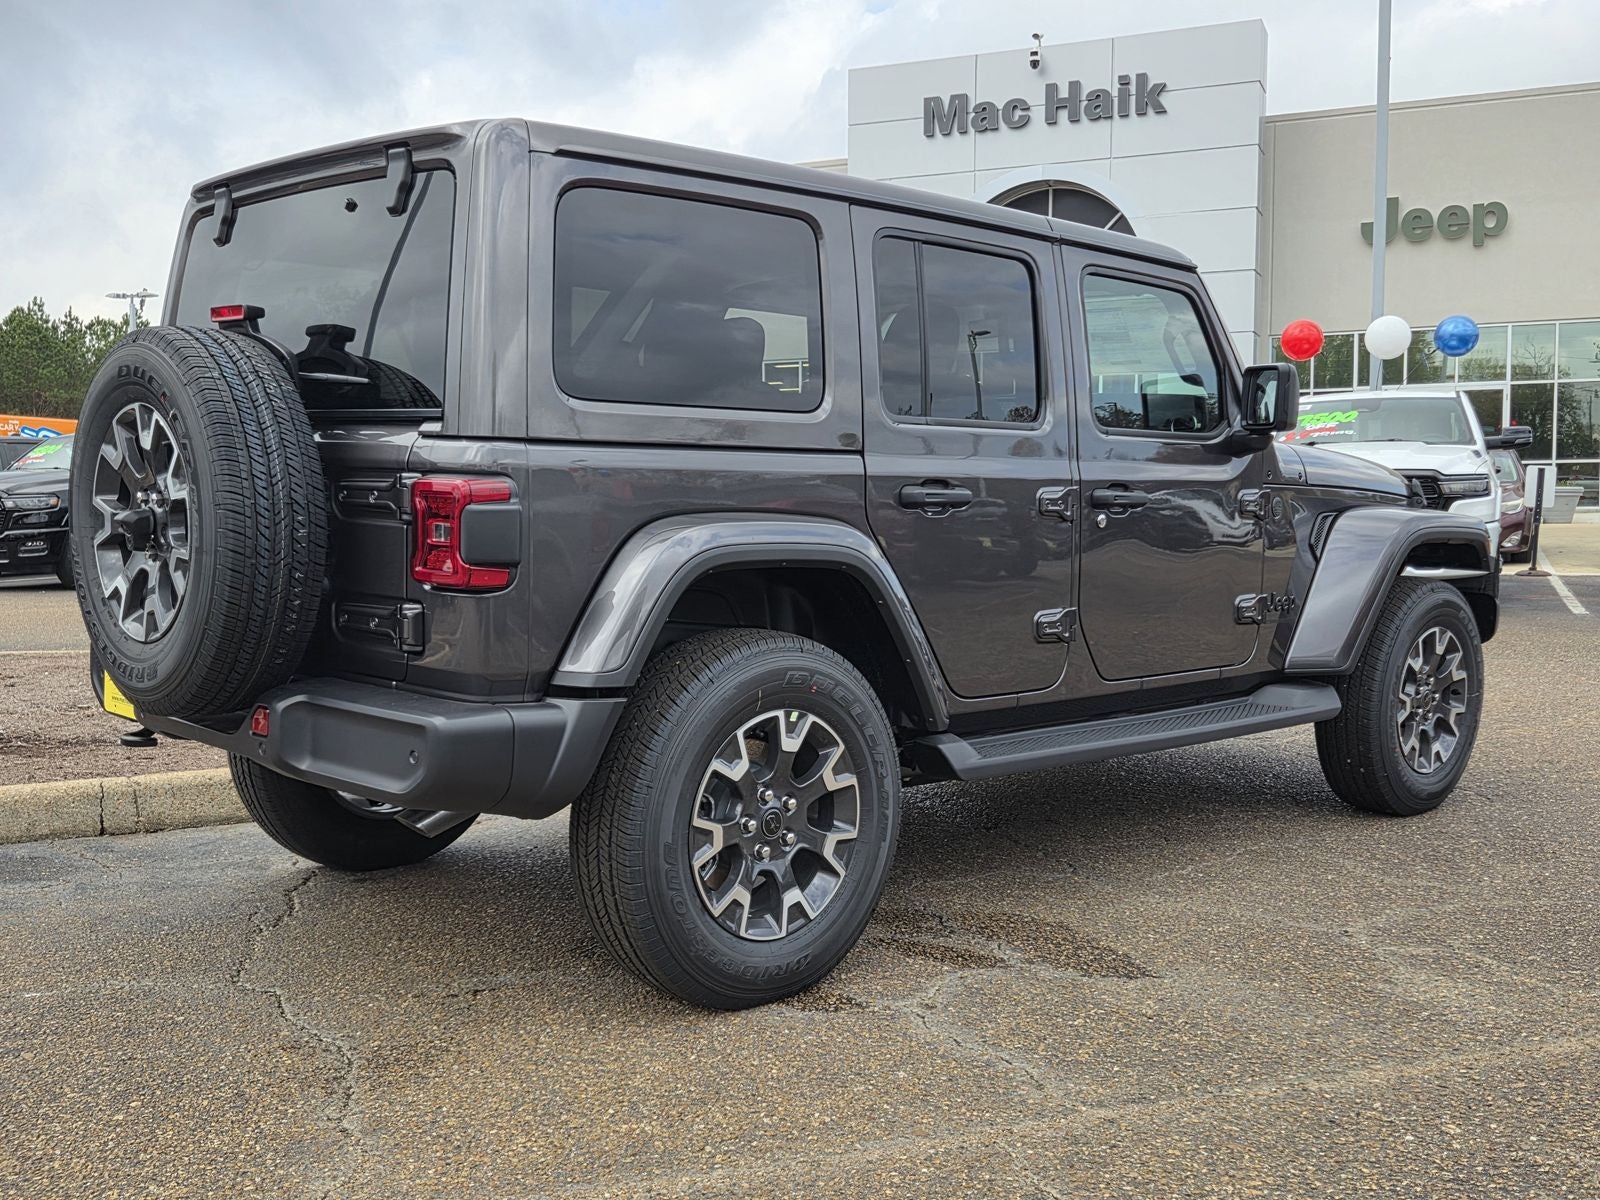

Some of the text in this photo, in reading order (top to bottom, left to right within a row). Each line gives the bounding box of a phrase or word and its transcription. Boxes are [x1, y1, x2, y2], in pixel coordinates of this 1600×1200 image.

[923, 72, 1167, 137] Mac Haik
[1360, 196, 1509, 247] Jeep
[1267, 592, 1296, 614] Jeep
[782, 670, 889, 779] DUELER
[663, 841, 812, 980] BRIDGESTONE
